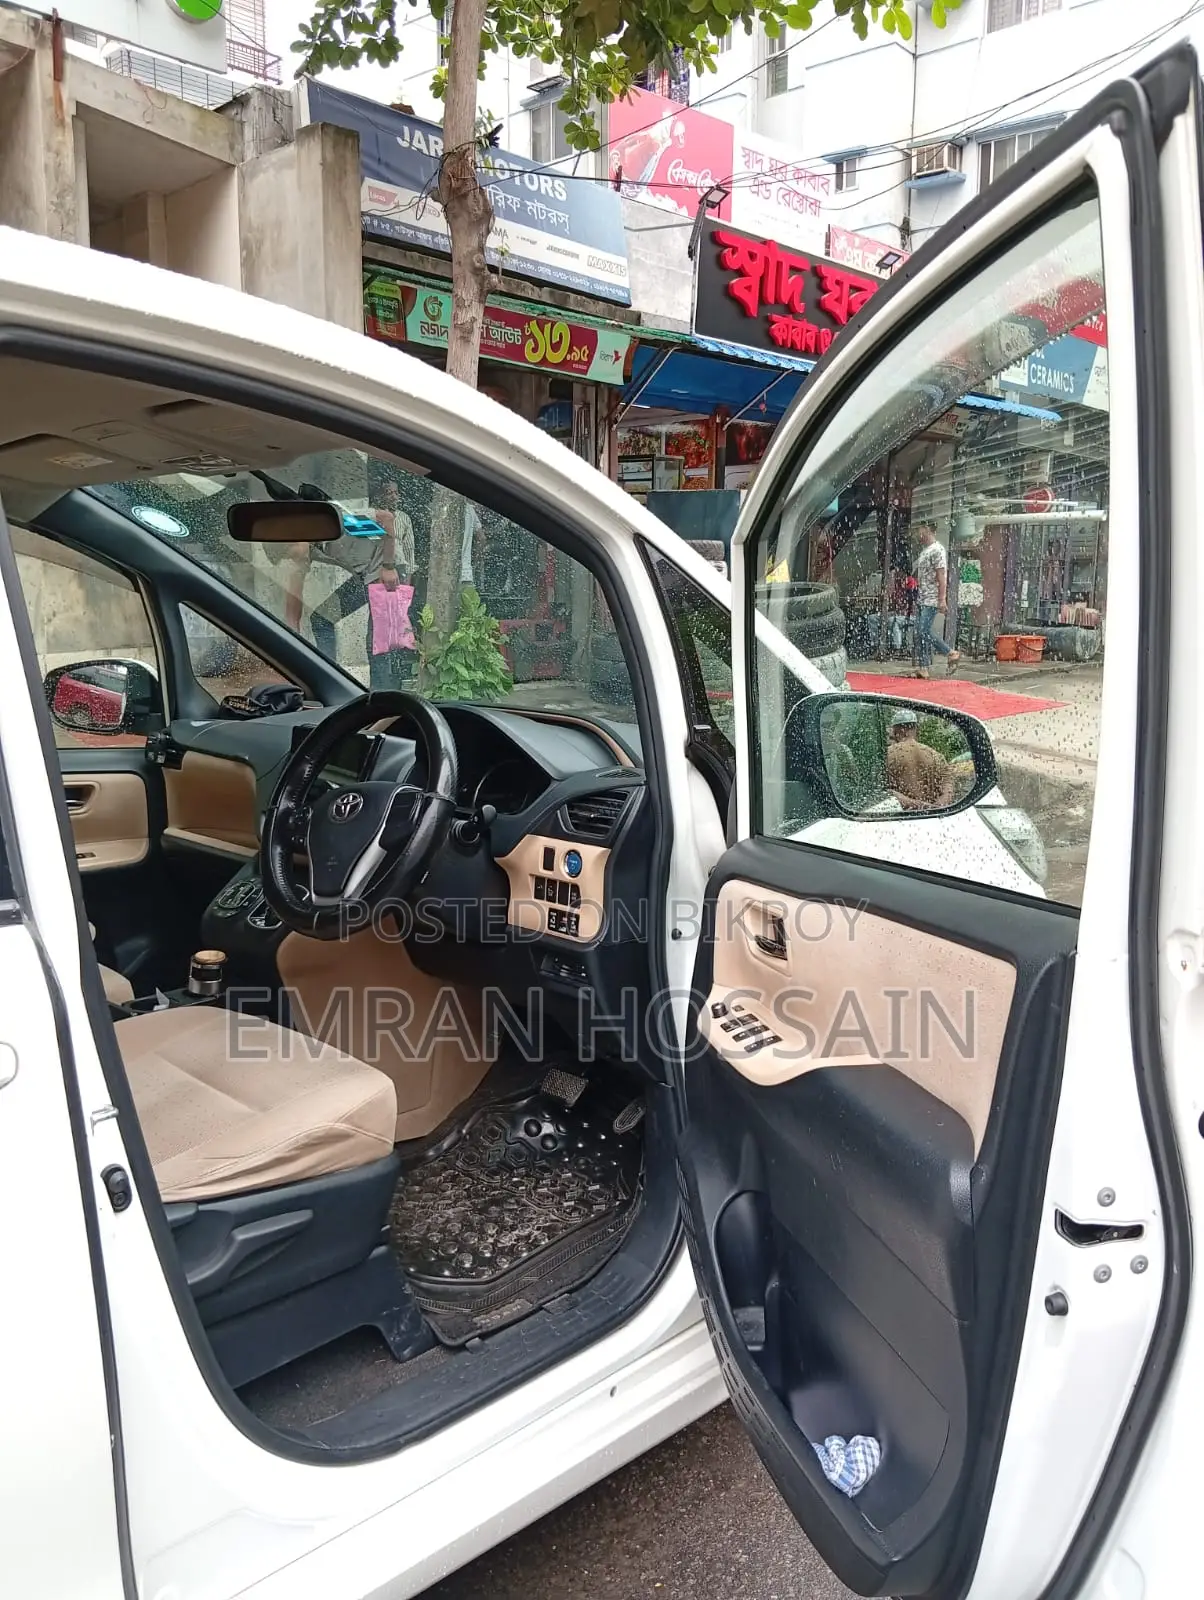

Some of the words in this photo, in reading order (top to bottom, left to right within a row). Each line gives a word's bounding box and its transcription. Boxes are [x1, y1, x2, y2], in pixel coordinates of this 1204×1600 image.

[397, 125, 443, 157] JAR
[791, 165, 830, 196] কাবাব
[587, 254, 627, 277] MAXXIS
[712, 230, 811, 318] স্বাদ
[489, 325, 522, 345] আউট
[768, 313, 818, 354] কাবাব
[1030, 363, 1075, 394] CERAMICS
